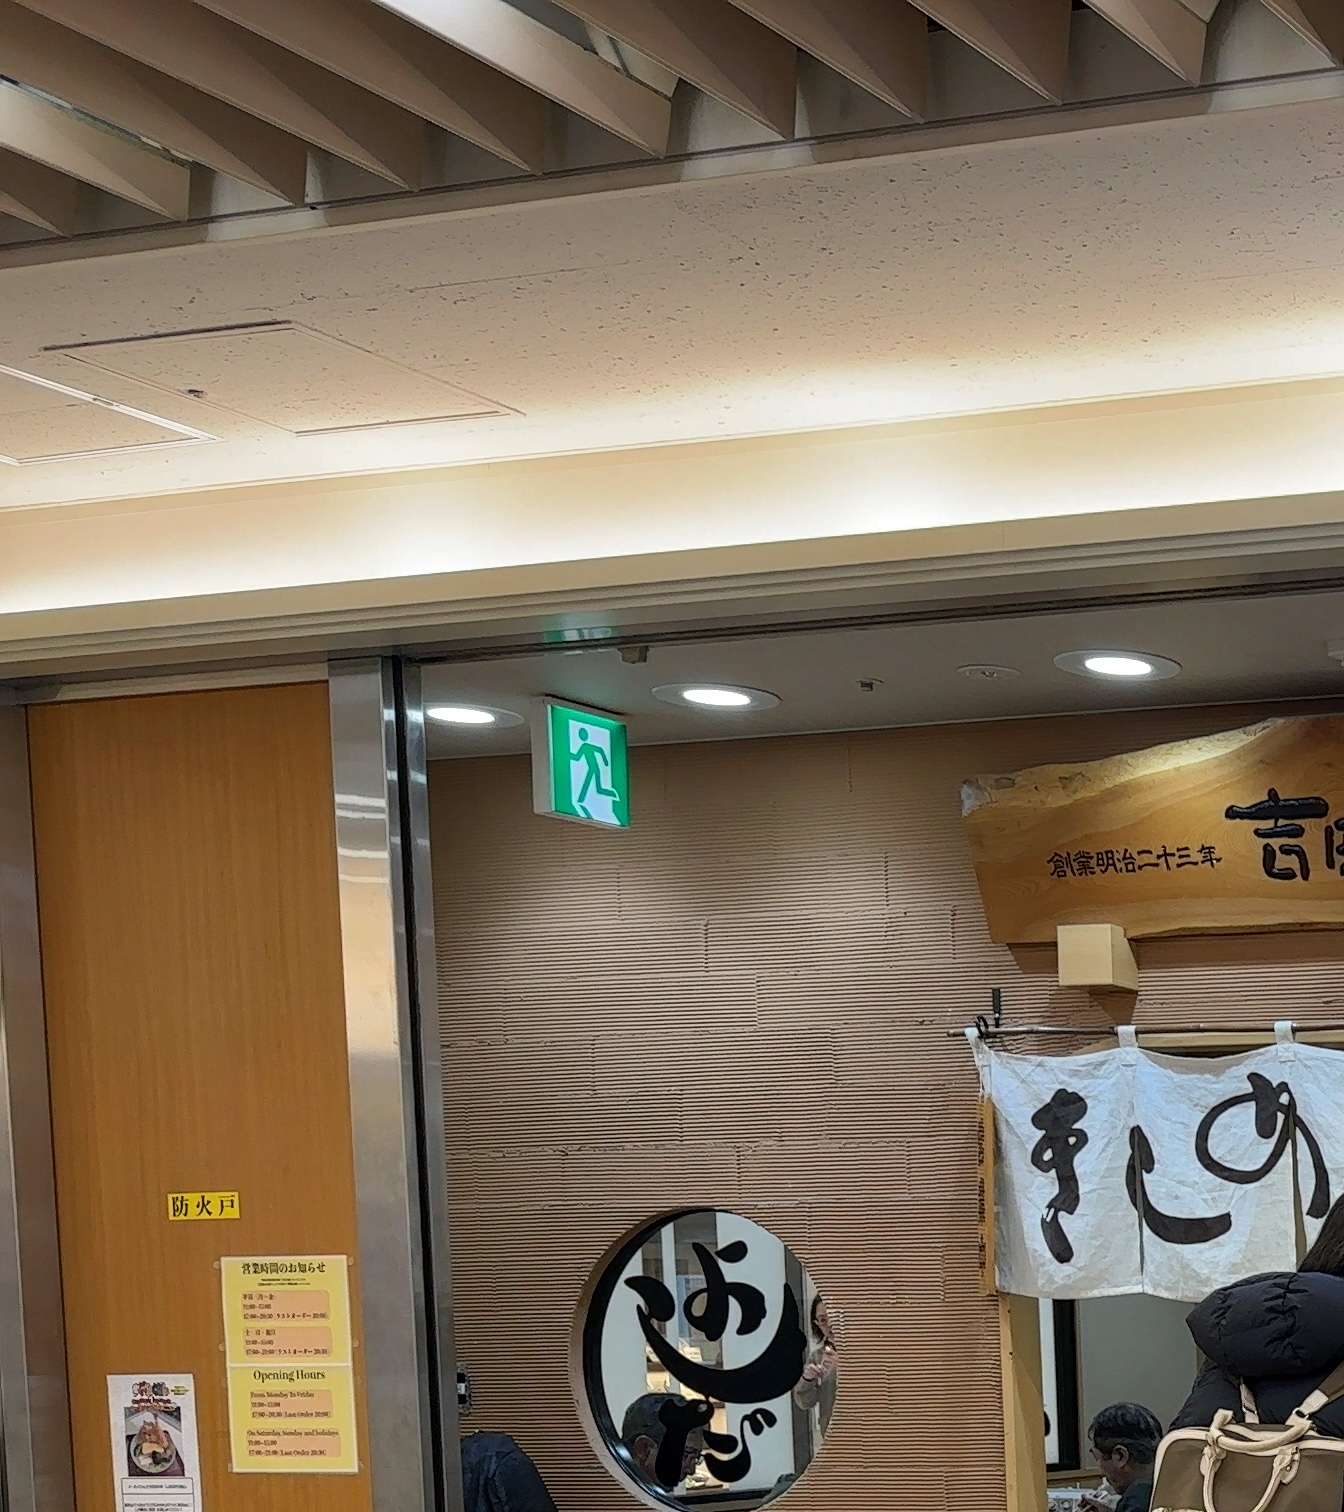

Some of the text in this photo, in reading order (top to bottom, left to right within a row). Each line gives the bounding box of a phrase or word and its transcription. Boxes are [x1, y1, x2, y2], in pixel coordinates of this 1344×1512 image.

[1047, 844, 1222, 880] 創業明治二十三年
[172, 1195, 235, 1217] 防火戸
[241, 1262, 326, 1275] 営業時間のお知らせ
[253, 1369, 326, 1383] Opening Hours
